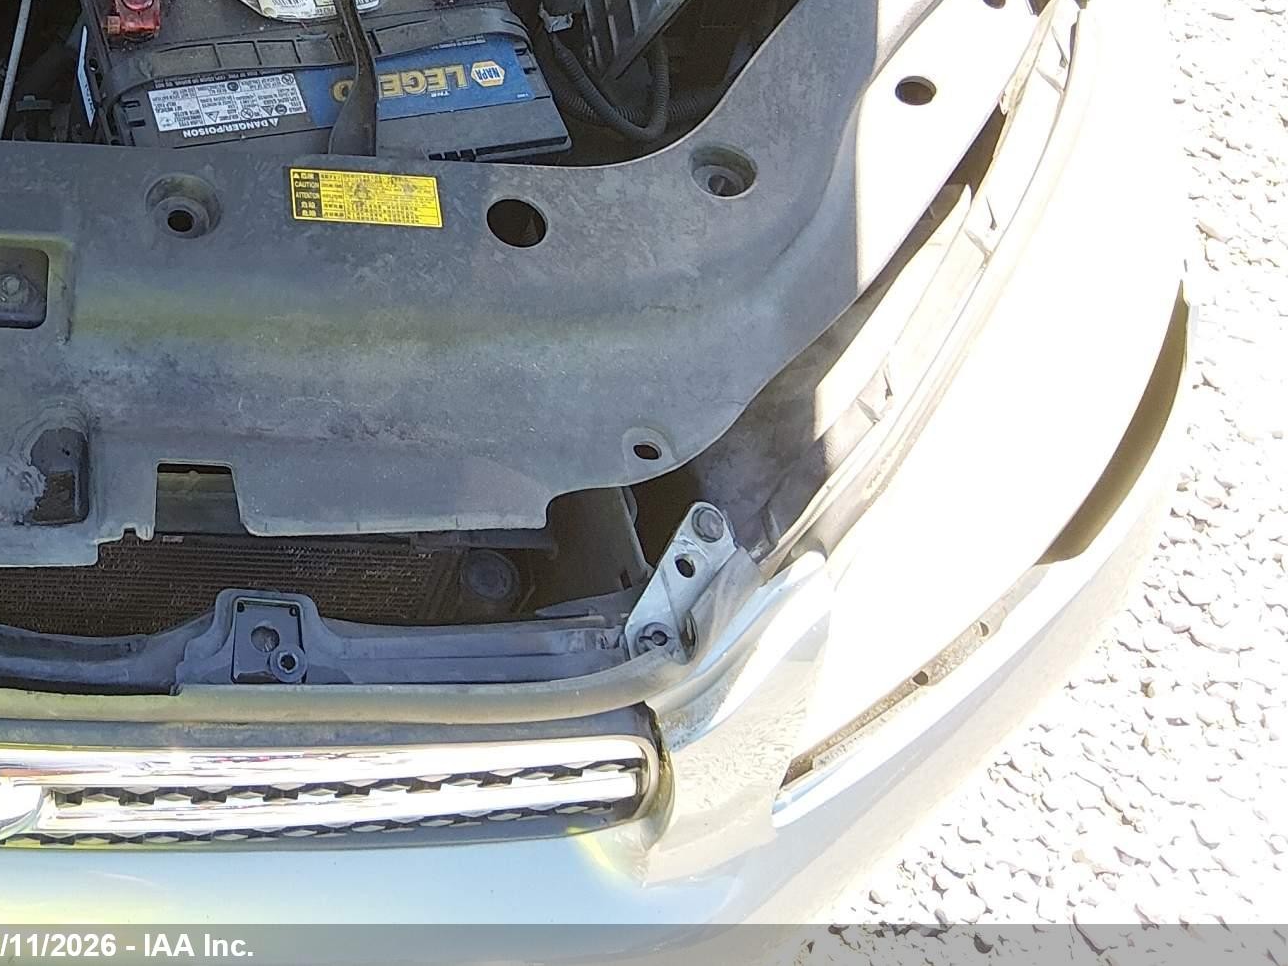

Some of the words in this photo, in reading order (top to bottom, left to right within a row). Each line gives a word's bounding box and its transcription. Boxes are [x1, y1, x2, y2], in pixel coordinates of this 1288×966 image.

[474, 67, 501, 81] NAPA
[331, 65, 468, 103] LEGED
[182, 119, 269, 139] DANGER/POISON
[294, 181, 320, 189] CAUTION
